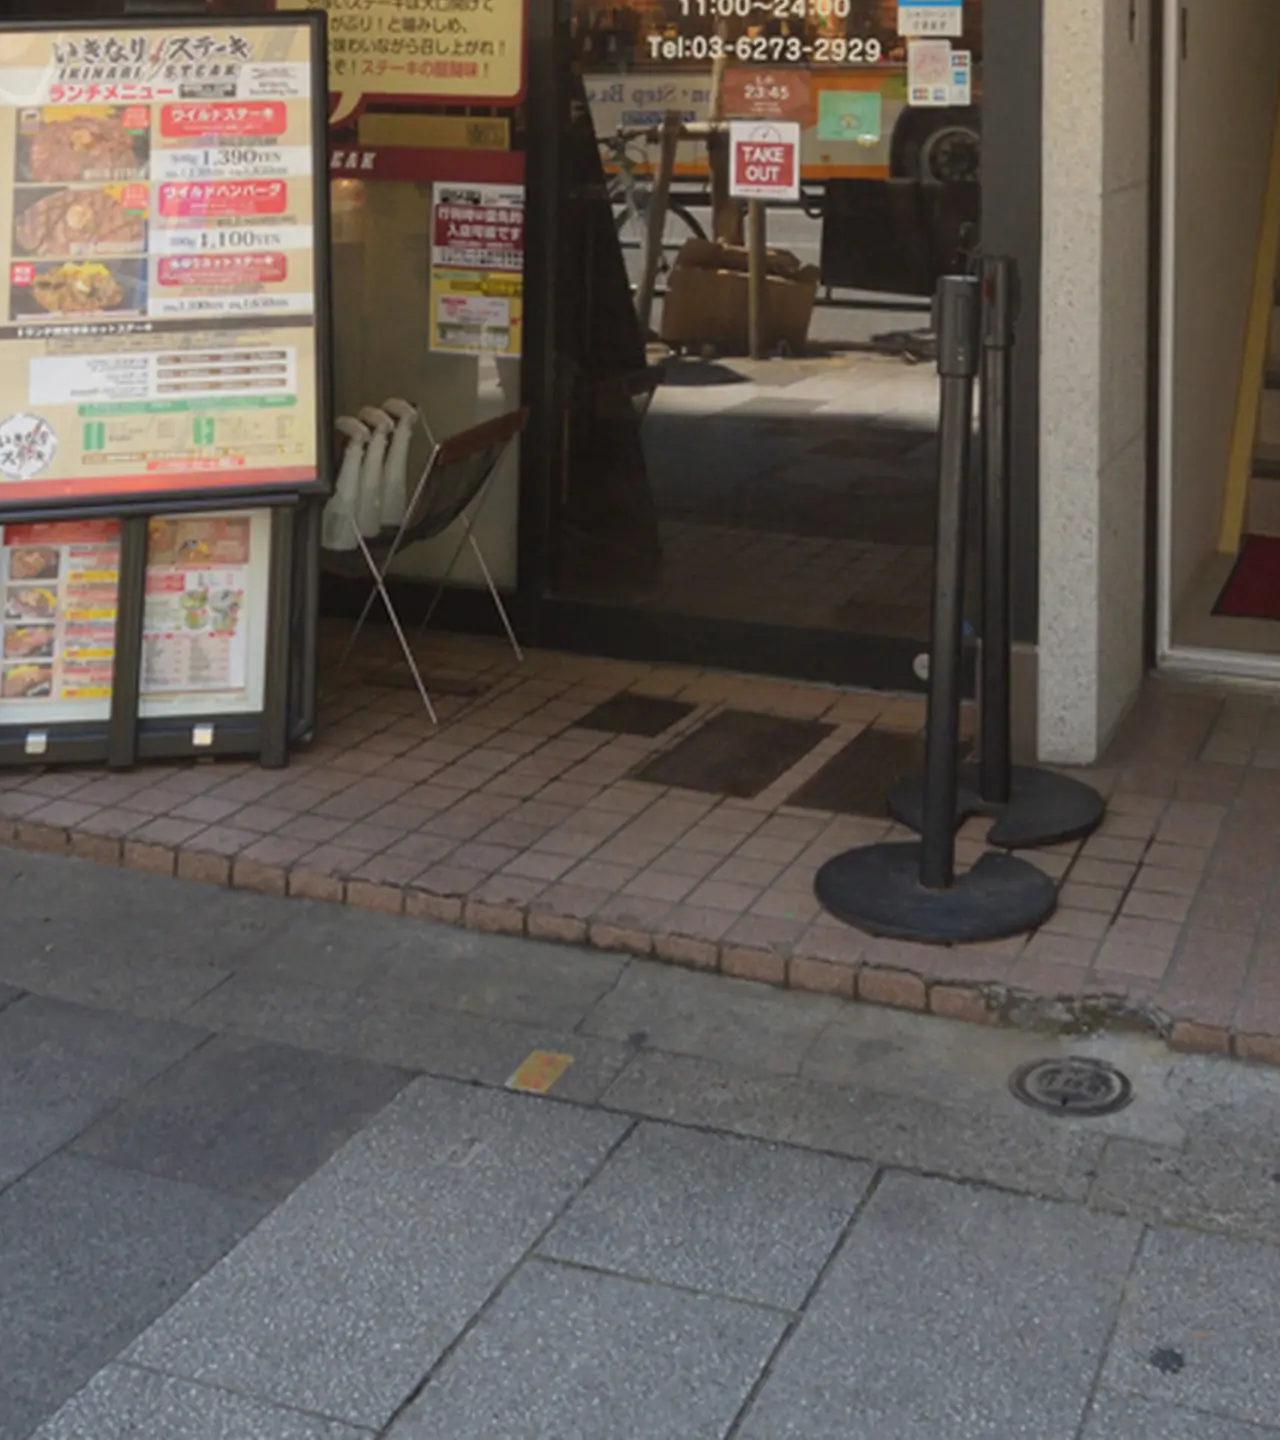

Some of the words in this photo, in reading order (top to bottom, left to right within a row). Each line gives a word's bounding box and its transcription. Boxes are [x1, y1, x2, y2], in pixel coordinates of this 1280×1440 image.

[170, 35, 250, 60] ステーキ
[647, 35, 882, 62] Tel:03-6273-2929
[48, 83, 174, 104] ランチメニュー
[330, 150, 377, 170] EAK
[741, 145, 786, 164] TAKE
[746, 164, 782, 184] OUT
